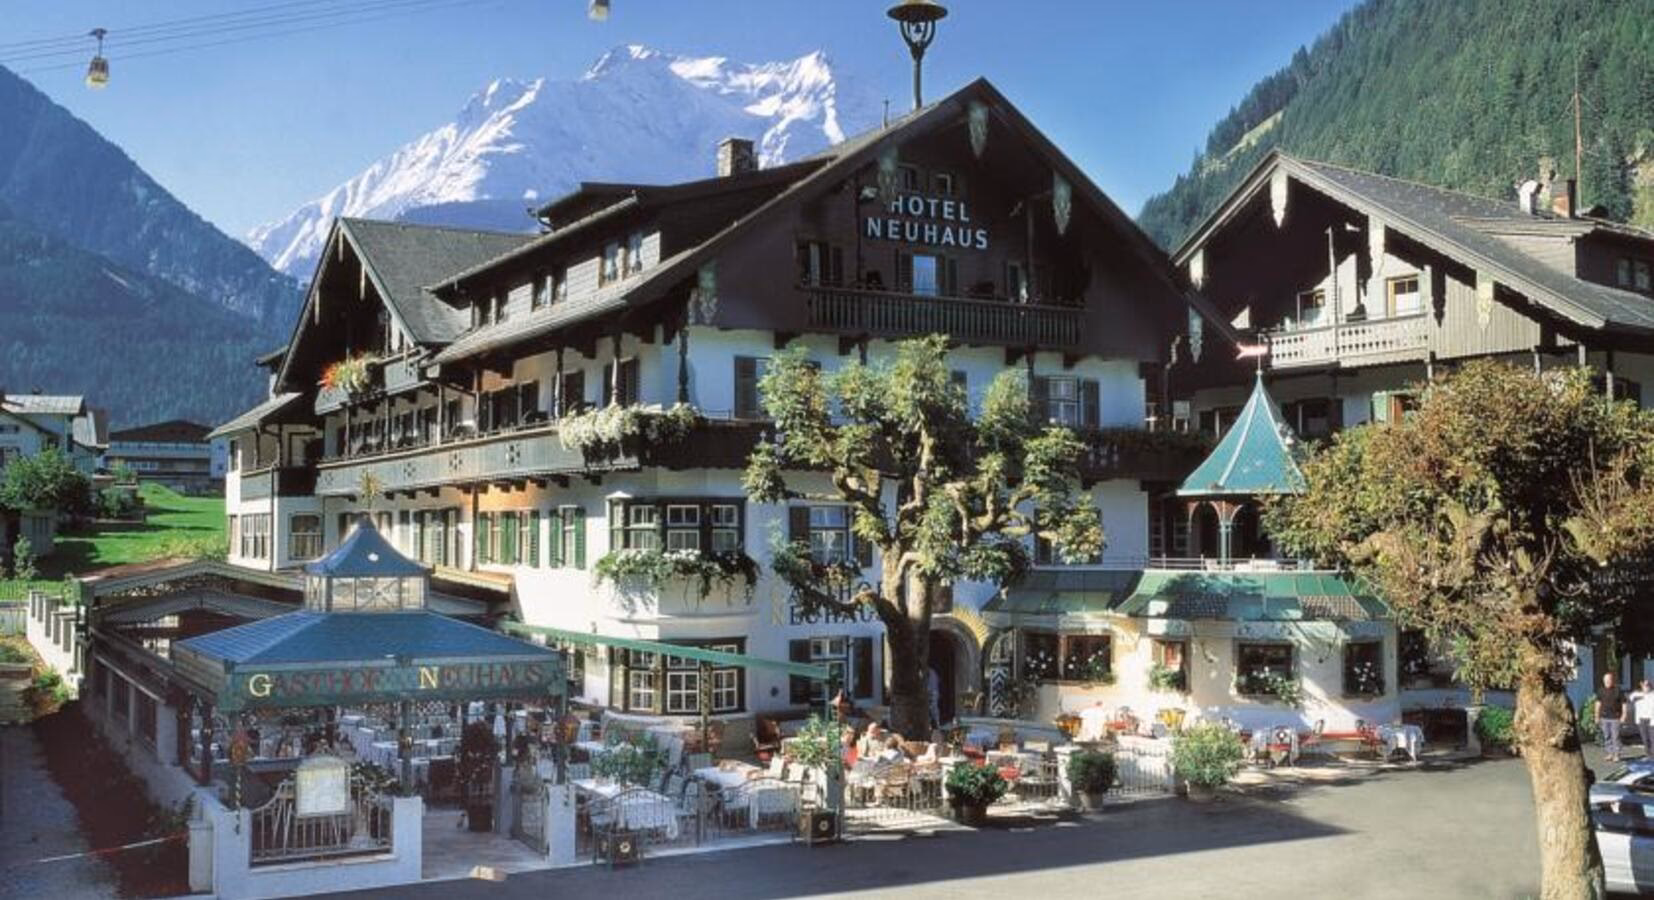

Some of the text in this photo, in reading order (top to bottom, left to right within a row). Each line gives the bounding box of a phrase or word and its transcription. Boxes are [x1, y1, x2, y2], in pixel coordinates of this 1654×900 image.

[891, 195, 969, 221] HOTEL
[867, 217, 988, 249] NEUHAUS
[418, 663, 542, 689] NEUHAUS
